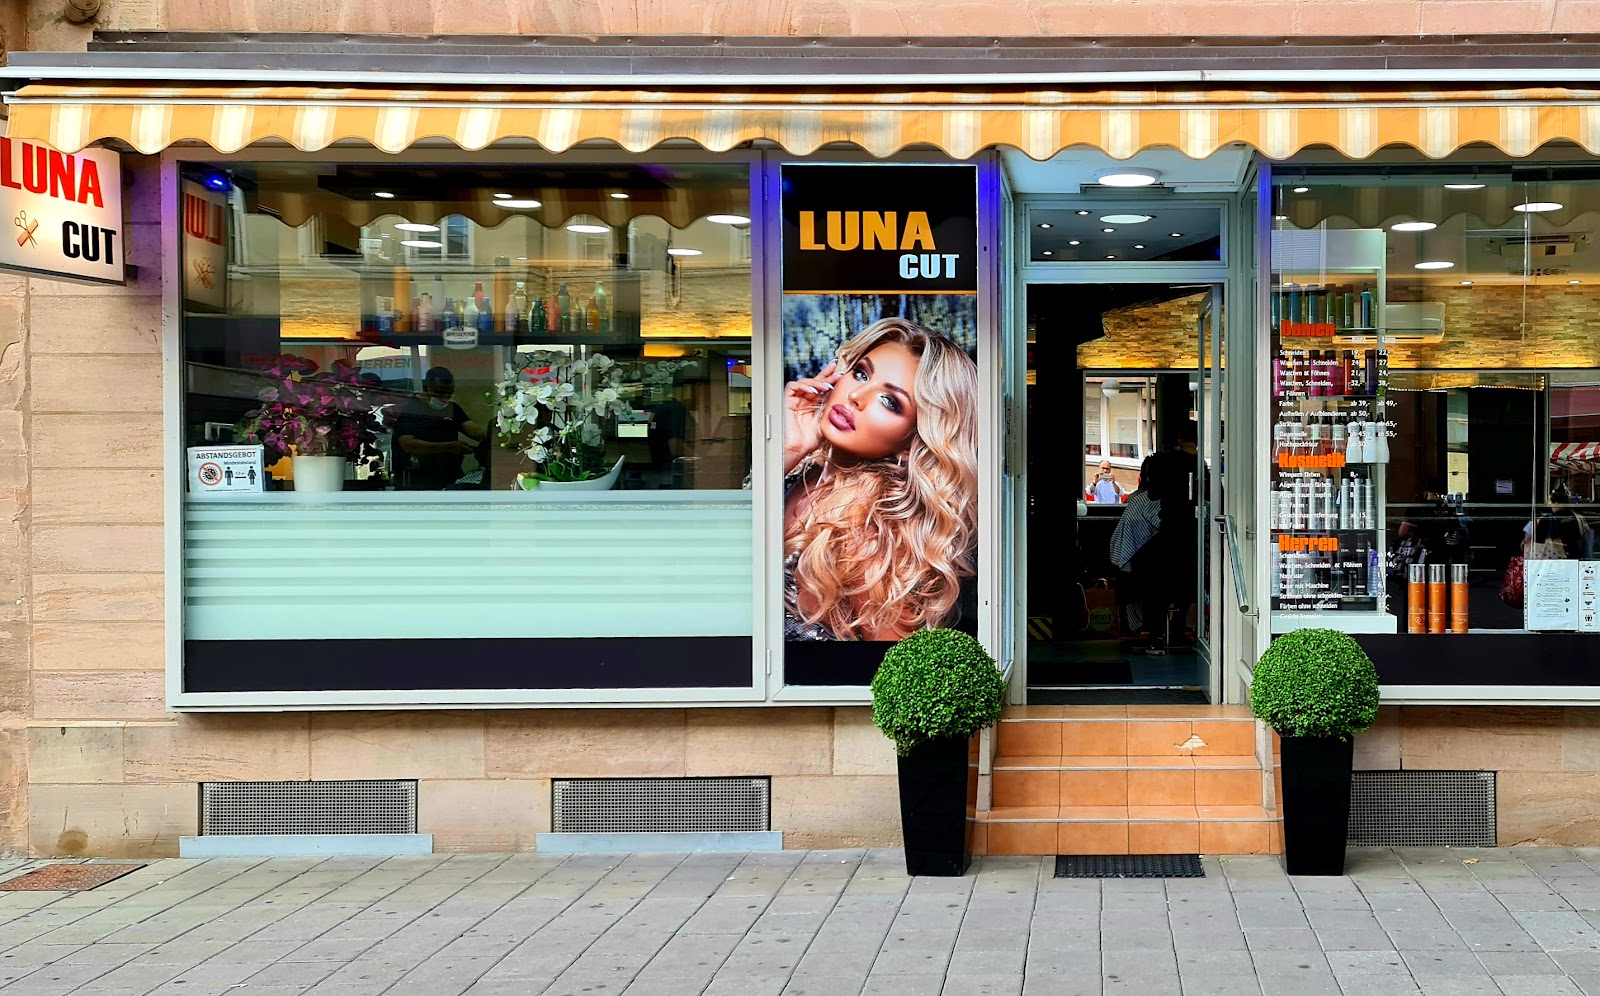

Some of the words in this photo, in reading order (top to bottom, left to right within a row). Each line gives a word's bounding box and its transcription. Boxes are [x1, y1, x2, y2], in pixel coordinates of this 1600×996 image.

[0, 136, 104, 208] LUNA
[62, 220, 117, 264] CUT
[800, 211, 936, 250] LUNA
[899, 254, 959, 278] CUT
[1278, 534, 1338, 552] Herren
[1305, 561, 1331, 569] Schneiden
